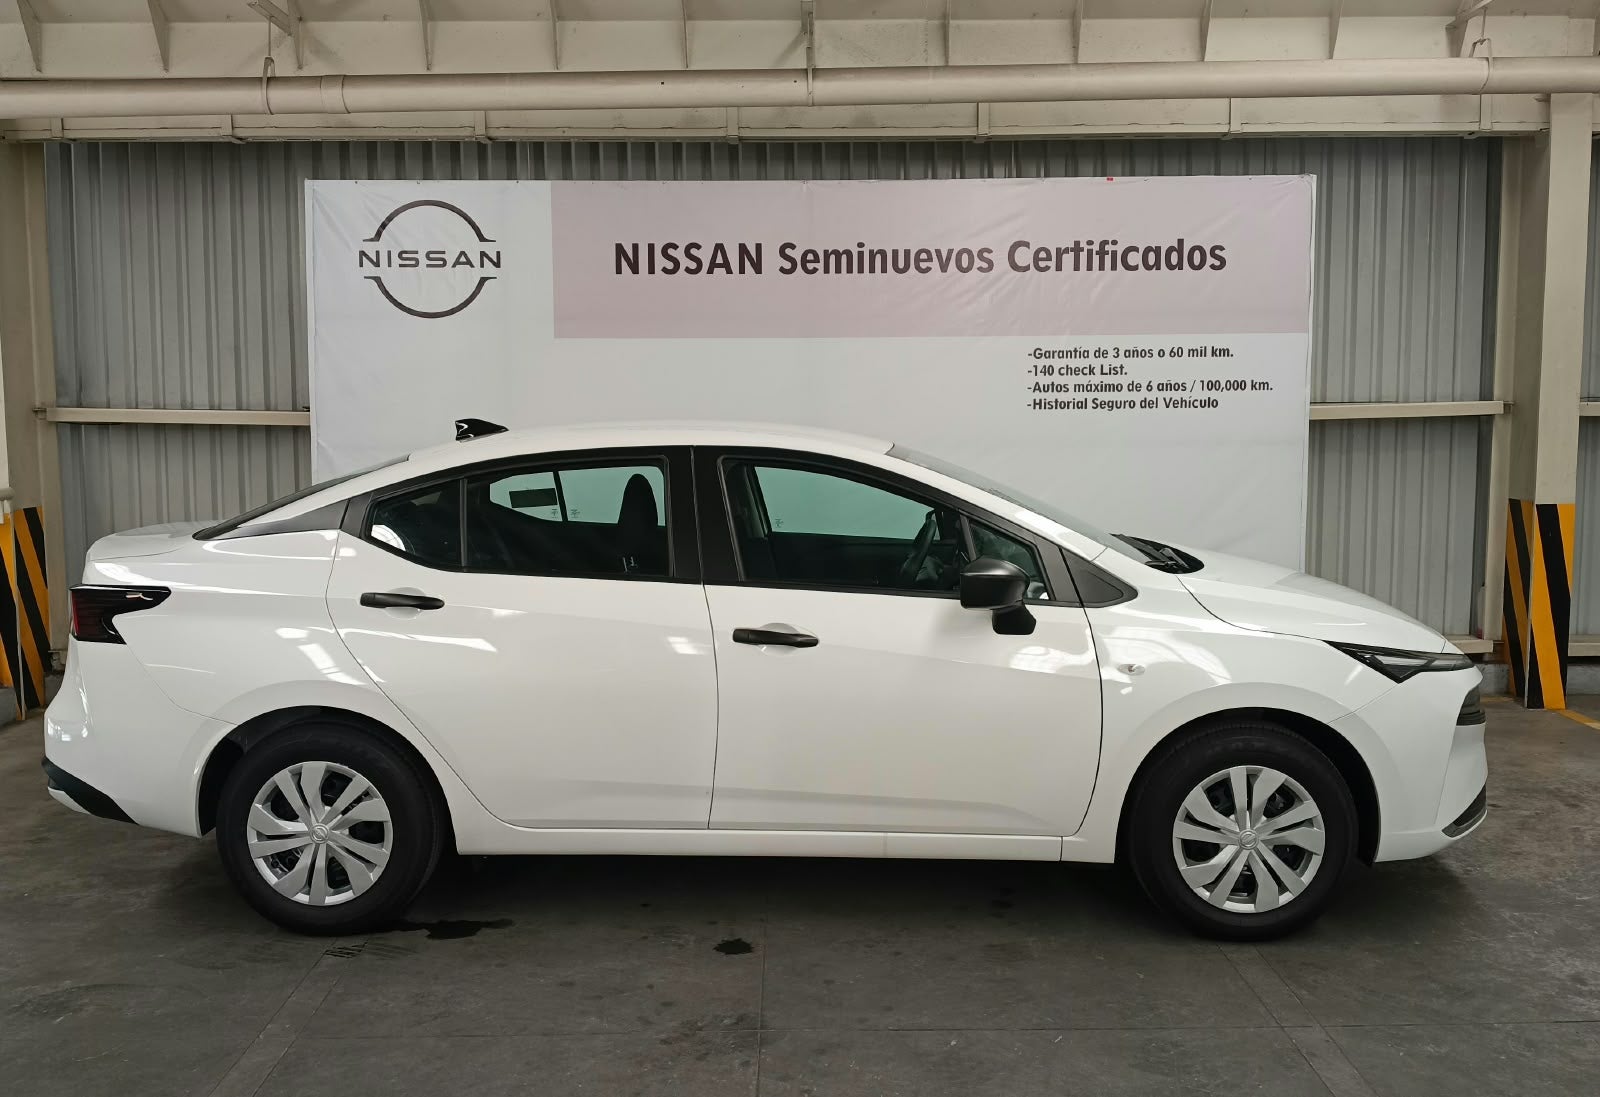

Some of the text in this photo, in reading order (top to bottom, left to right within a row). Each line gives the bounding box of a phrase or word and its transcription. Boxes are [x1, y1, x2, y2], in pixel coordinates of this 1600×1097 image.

[358, 249, 501, 269] NISSAN
[615, 238, 1228, 275] NISSAN Seminuevos Certificados
[1028, 345, 1234, 360] -Garantía de 3 años o 60 mil km.
[1027, 364, 1128, 377] -140 check List.
[1027, 379, 1273, 393] -Autos máximo de 6 años / 100,000 km.
[1027, 396, 1219, 412] -Historial Seguro del Vehículo
